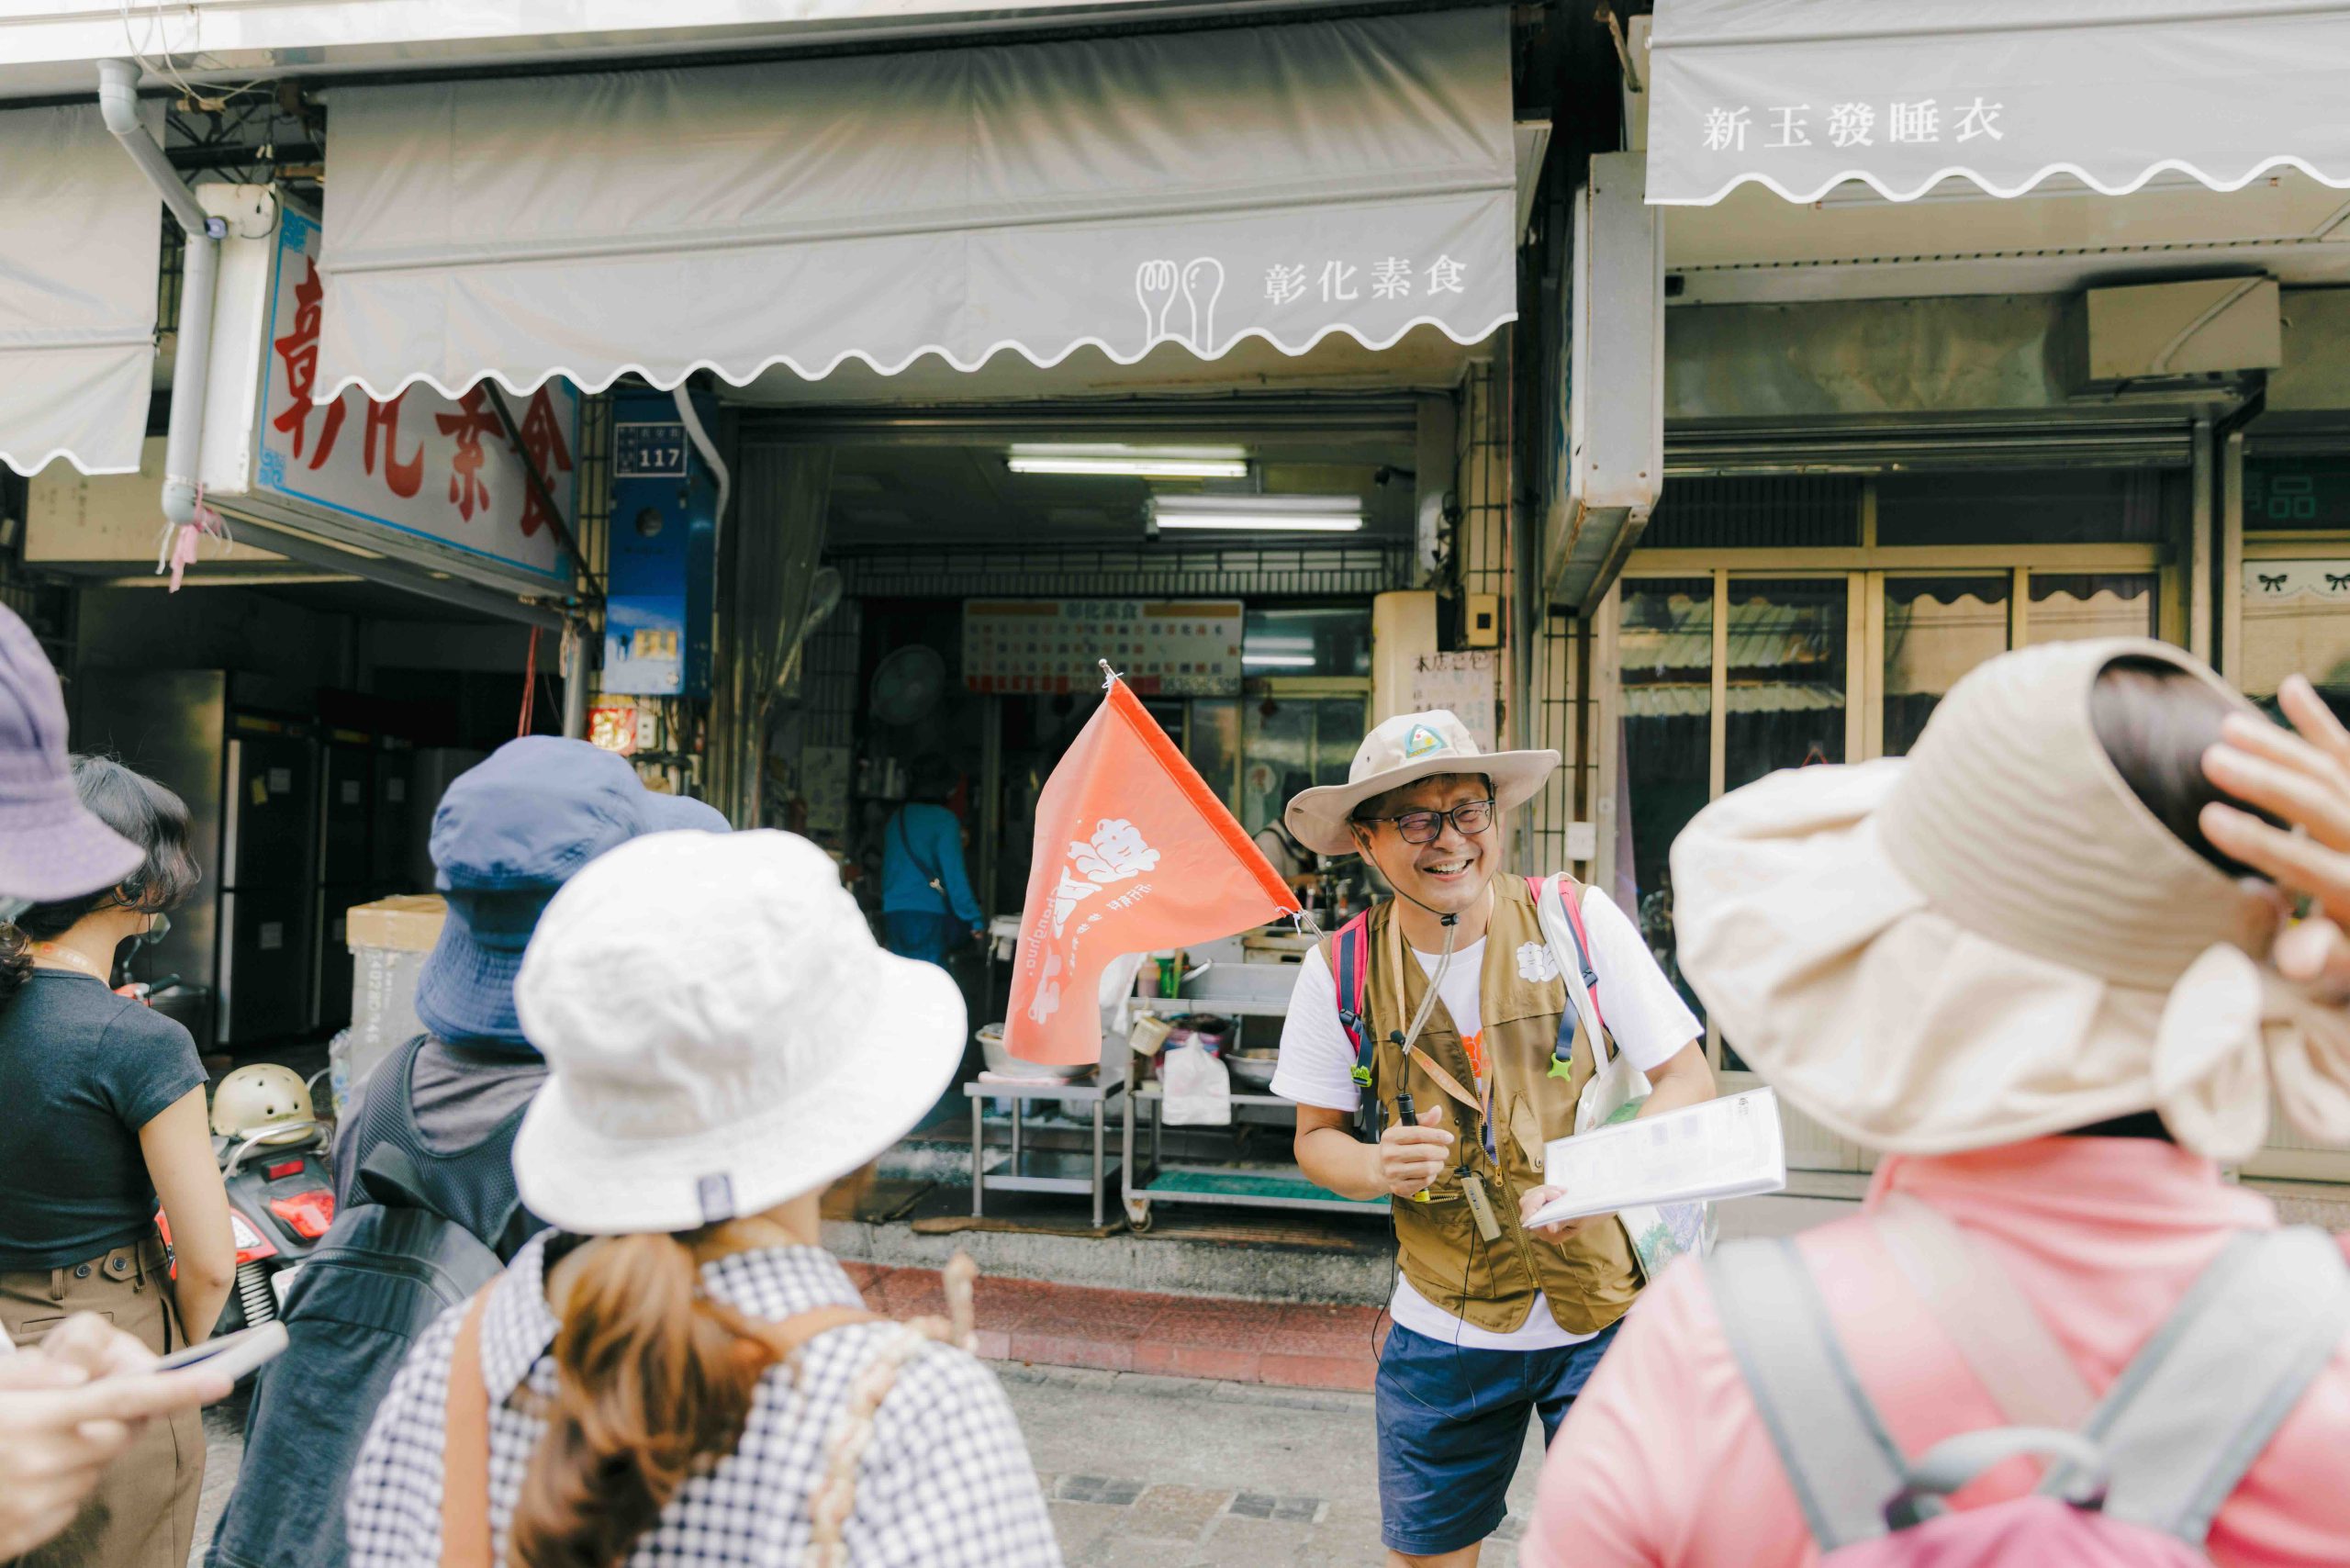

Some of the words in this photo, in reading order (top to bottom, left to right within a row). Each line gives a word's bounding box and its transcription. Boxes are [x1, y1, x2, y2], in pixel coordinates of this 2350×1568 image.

[1702, 96, 2005, 151] 新玉發睡衣
[1264, 254, 1469, 306] 彰化素食
[639, 448, 680, 467] 117
